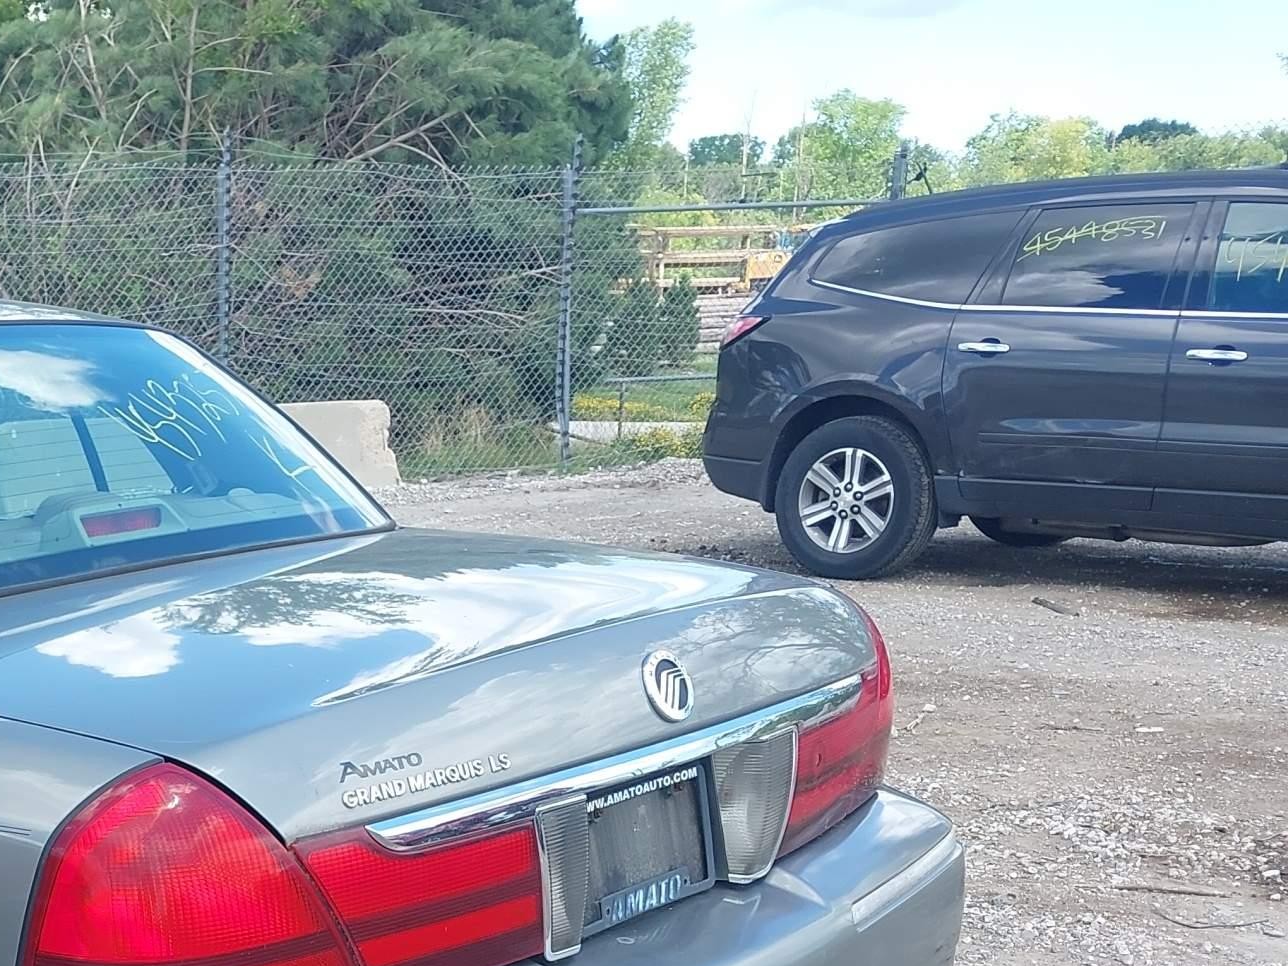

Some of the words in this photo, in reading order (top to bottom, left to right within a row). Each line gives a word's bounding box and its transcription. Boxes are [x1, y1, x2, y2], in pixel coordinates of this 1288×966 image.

[1022, 217, 1167, 257] 45448531
[339, 752, 423, 783] AMATO
[342, 779, 406, 809] GRAND
[407, 759, 484, 793] MARQUIS
[488, 753, 512, 773] LS
[586, 766, 698, 813] WW.AMATOAUTO.COM
[612, 874, 682, 922] AMATO
